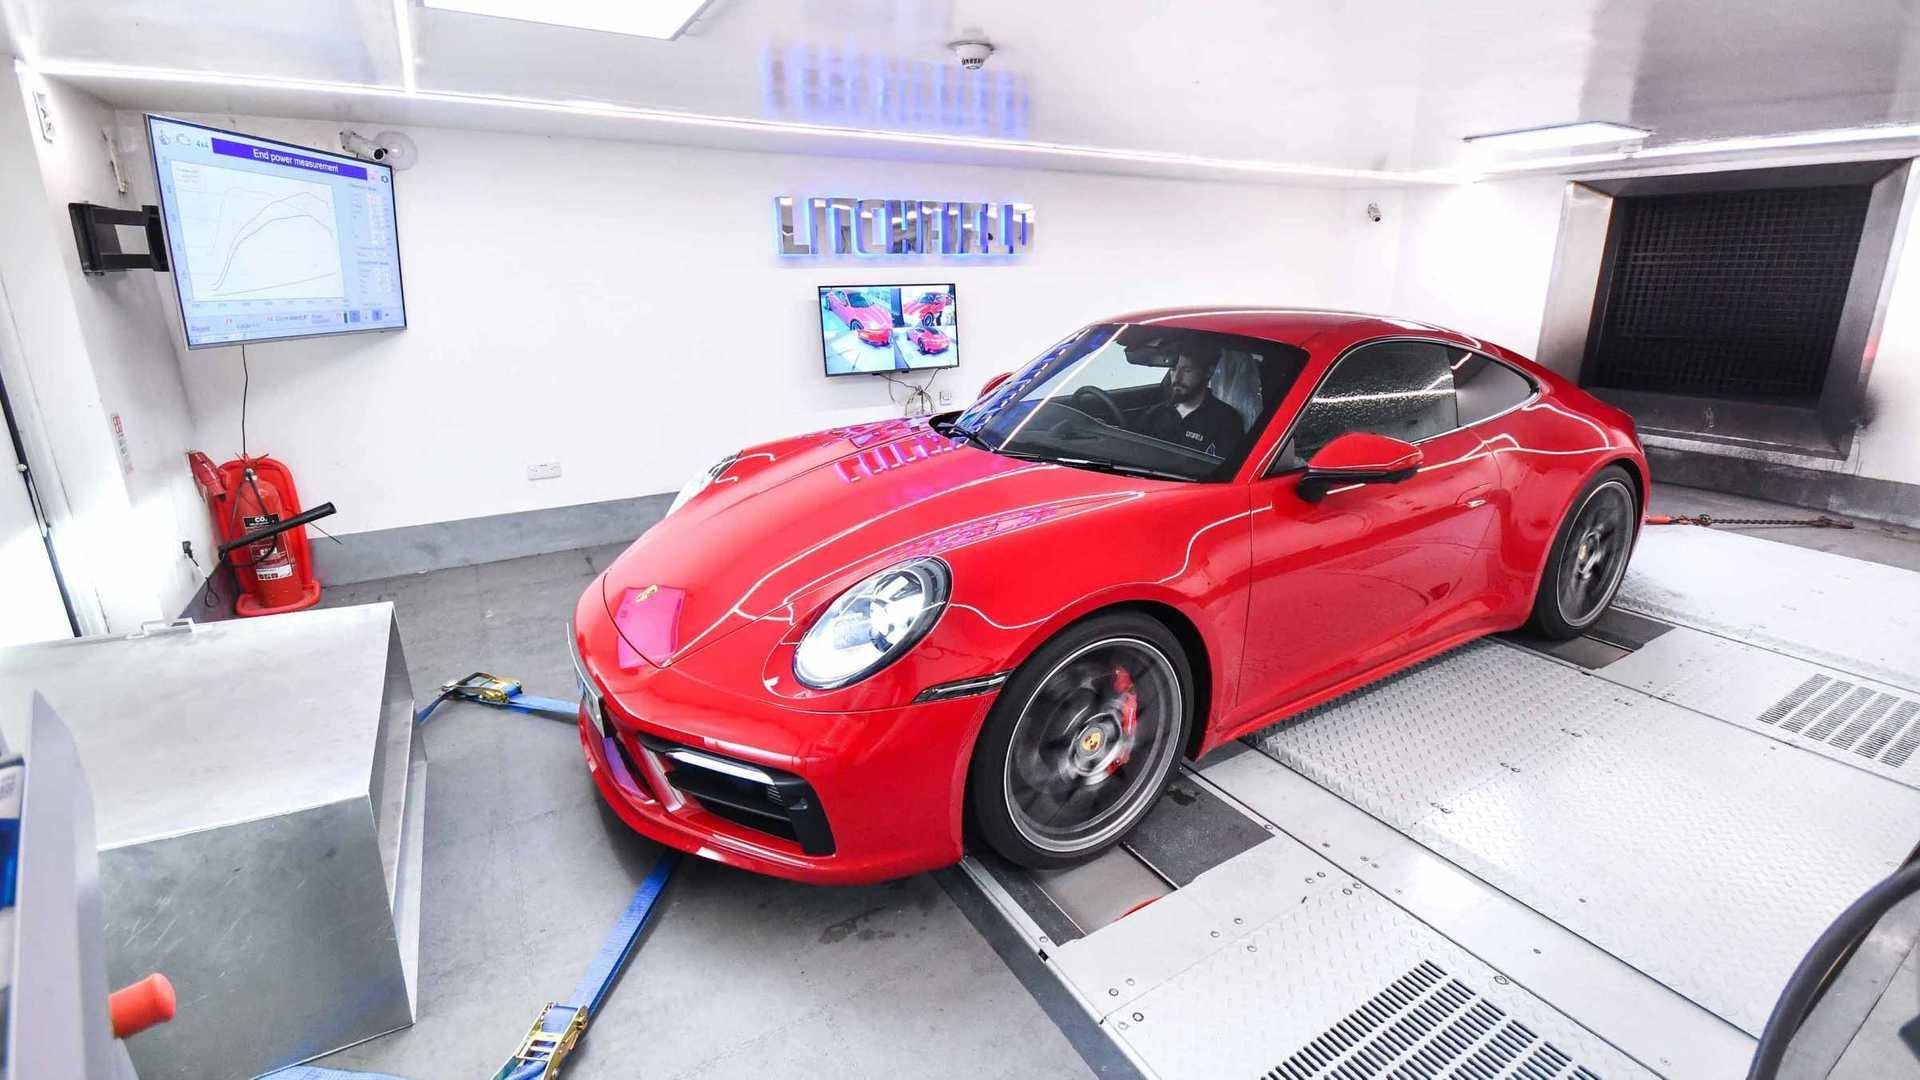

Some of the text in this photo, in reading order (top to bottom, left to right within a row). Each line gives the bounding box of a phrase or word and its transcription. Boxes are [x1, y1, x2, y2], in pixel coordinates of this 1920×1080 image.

[253, 148, 339, 172] End power measurement
